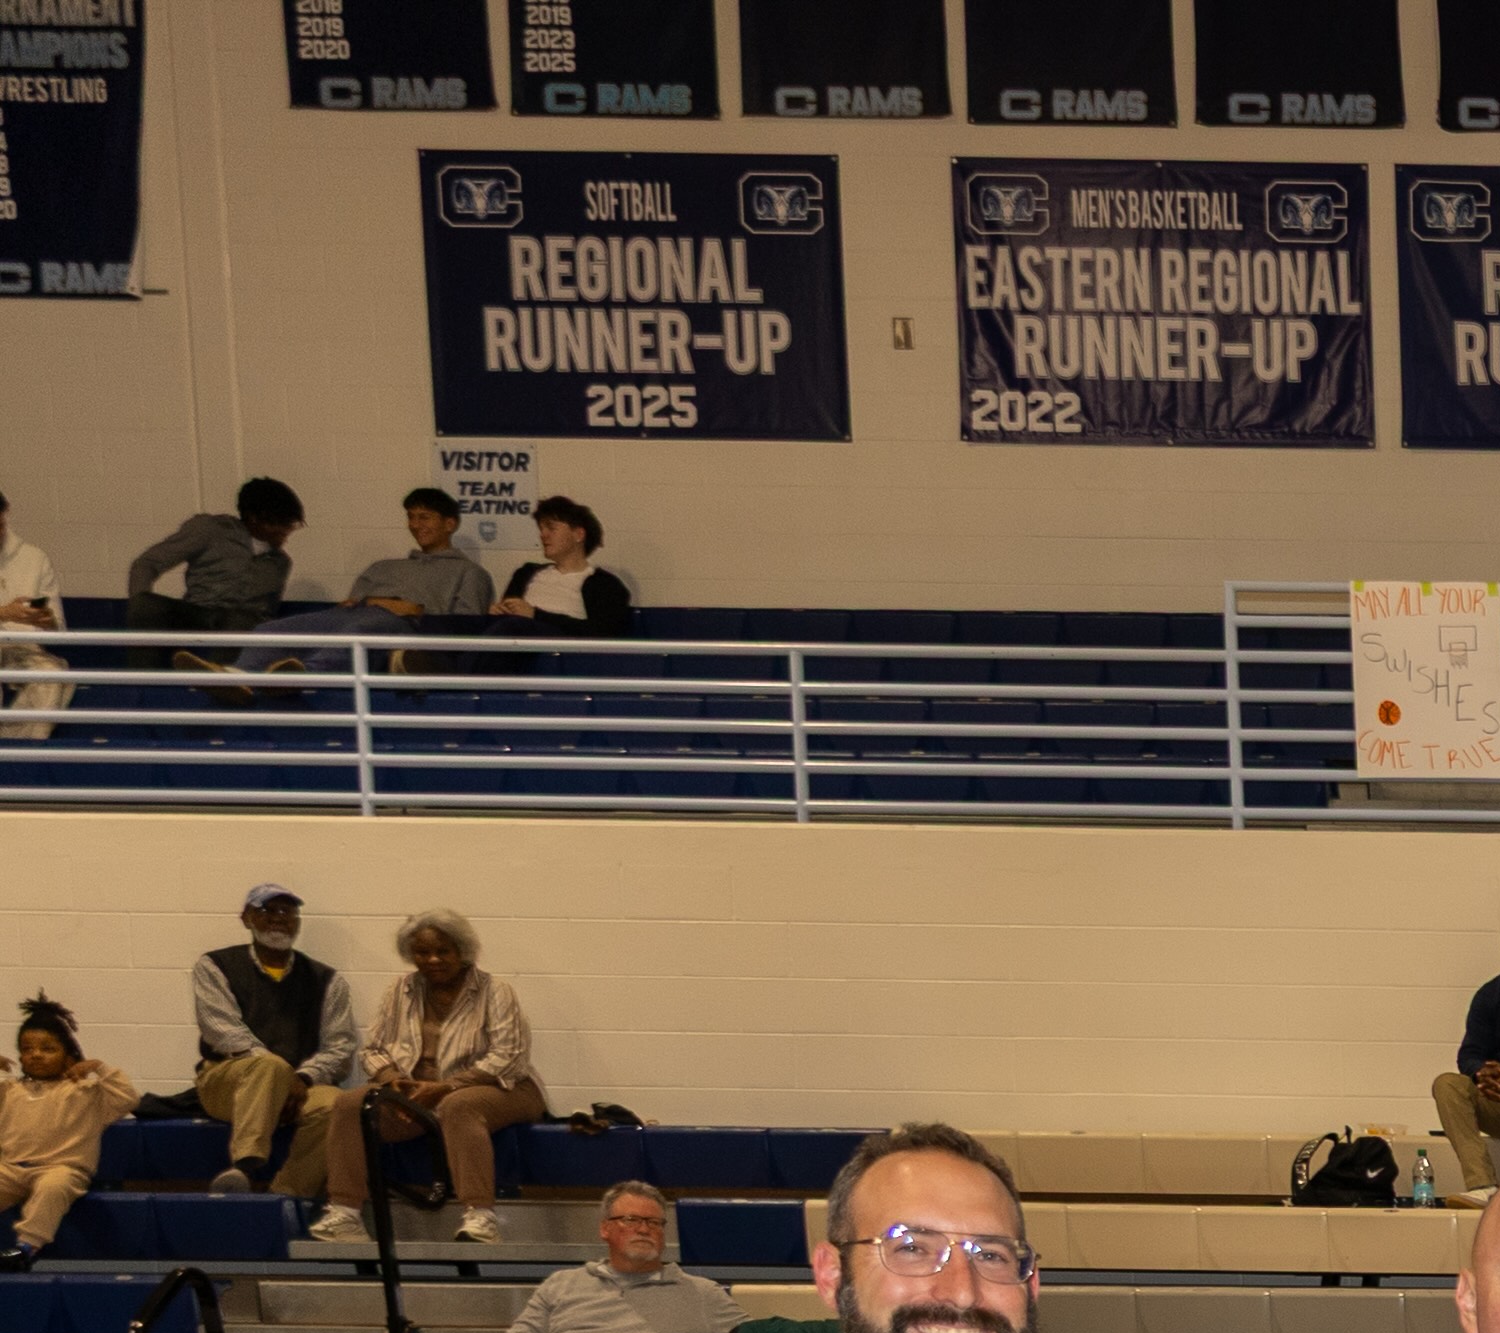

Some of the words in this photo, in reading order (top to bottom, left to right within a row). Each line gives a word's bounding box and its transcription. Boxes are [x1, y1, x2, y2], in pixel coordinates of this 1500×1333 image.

[526, 6, 572, 26] 2019
[525, 28, 575, 49] 2023
[525, 52, 576, 73] 2025
[373, 77, 467, 109] RAMS
[1052, 89, 1148, 122] RAMS
[585, 181, 677, 223] SOFTBALL
[1072, 189, 1127, 230] MEN'S
[1128, 191, 1243, 232] BASKETBALL
[509, 236, 764, 304] REGIONAL
[966, 246, 1151, 312] EASTERN
[1162, 248, 1361, 316] REGIONAL
[483, 308, 792, 374] RUNNER-UP
[1015, 316, 1319, 383] RUNNER-UP
[586, 385, 698, 429] 2025
[971, 391, 1083, 434] 2022
[441, 451, 530, 472] VISITOR
[458, 482, 515, 496] TEAM
[459, 500, 530, 514] EATING
[1354, 590, 1391, 621] MAY
[1396, 588, 1428, 617] ALL
[1435, 587, 1487, 616] YOUR
[1361, 632, 1500, 735] SWISHES
[1357, 730, 1413, 769] COME
